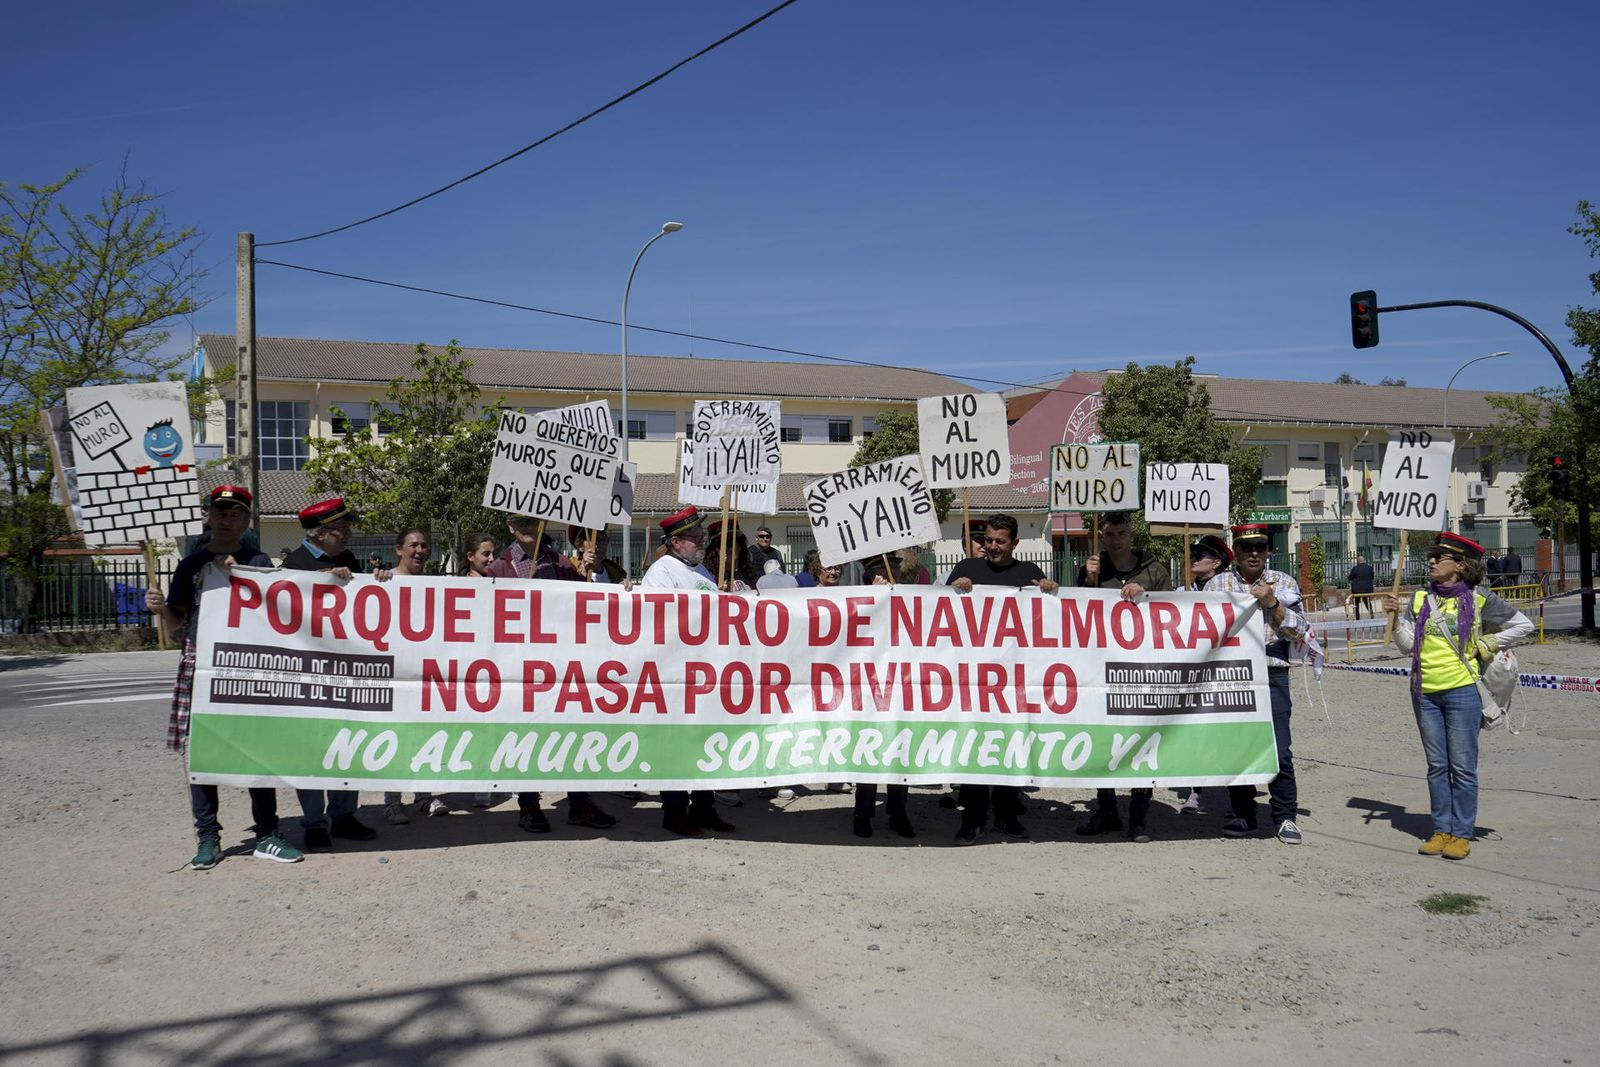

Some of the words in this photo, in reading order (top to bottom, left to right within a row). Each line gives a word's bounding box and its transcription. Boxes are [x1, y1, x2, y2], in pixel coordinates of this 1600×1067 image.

[75, 416, 91, 429] NO
[94, 408, 110, 419] AL
[942, 394, 977, 418] NO
[500, 414, 527, 434] NO
[536, 419, 619, 455] QUEREMOS
[695, 401, 779, 464] SOTERRAMIENTO
[946, 421, 978, 444] AL
[1067, 407, 1085, 435] IES
[82, 422, 120, 450] MURO
[1399, 431, 1432, 448] NO
[495, 440, 556, 469] MUROS
[571, 454, 610, 480] QUE
[932, 449, 1000, 482] MURO
[1010, 451, 1043, 465] Bilingual
[1056, 446, 1089, 471] NO
[1103, 445, 1132, 468] AL
[1395, 456, 1429, 480] AL
[535, 470, 573, 493] NOS
[1010, 469, 1036, 480] Section
[1152, 463, 1177, 481] NO
[1191, 464, 1216, 481] AL
[490, 482, 587, 523] DIVIDAN
[807, 461, 931, 528] SOTERRAMIENTO
[1054, 478, 1125, 505] MURO
[1152, 489, 1211, 511] MURO
[1375, 491, 1437, 518] MURO
[227, 575, 476, 651] PORQUE
[494, 589, 557, 644] EL
[575, 591, 789, 647] FUTURO
[806, 596, 875, 647] DE
[890, 596, 1240, 650] NAVALMORAL
[421, 658, 501, 713] NO
[522, 660, 668, 714] PASA
[684, 661, 794, 715] POR
[810, 662, 1078, 715] DIVIDIRLO
[1560, 683, 1594, 692] SEGURIDAD
[322, 727, 398, 771] NO
[410, 730, 473, 772] AL
[490, 730, 651, 773] MURO.
[697, 727, 1092, 773] SOTERRAMIENTO
[1108, 732, 1162, 771] YA
